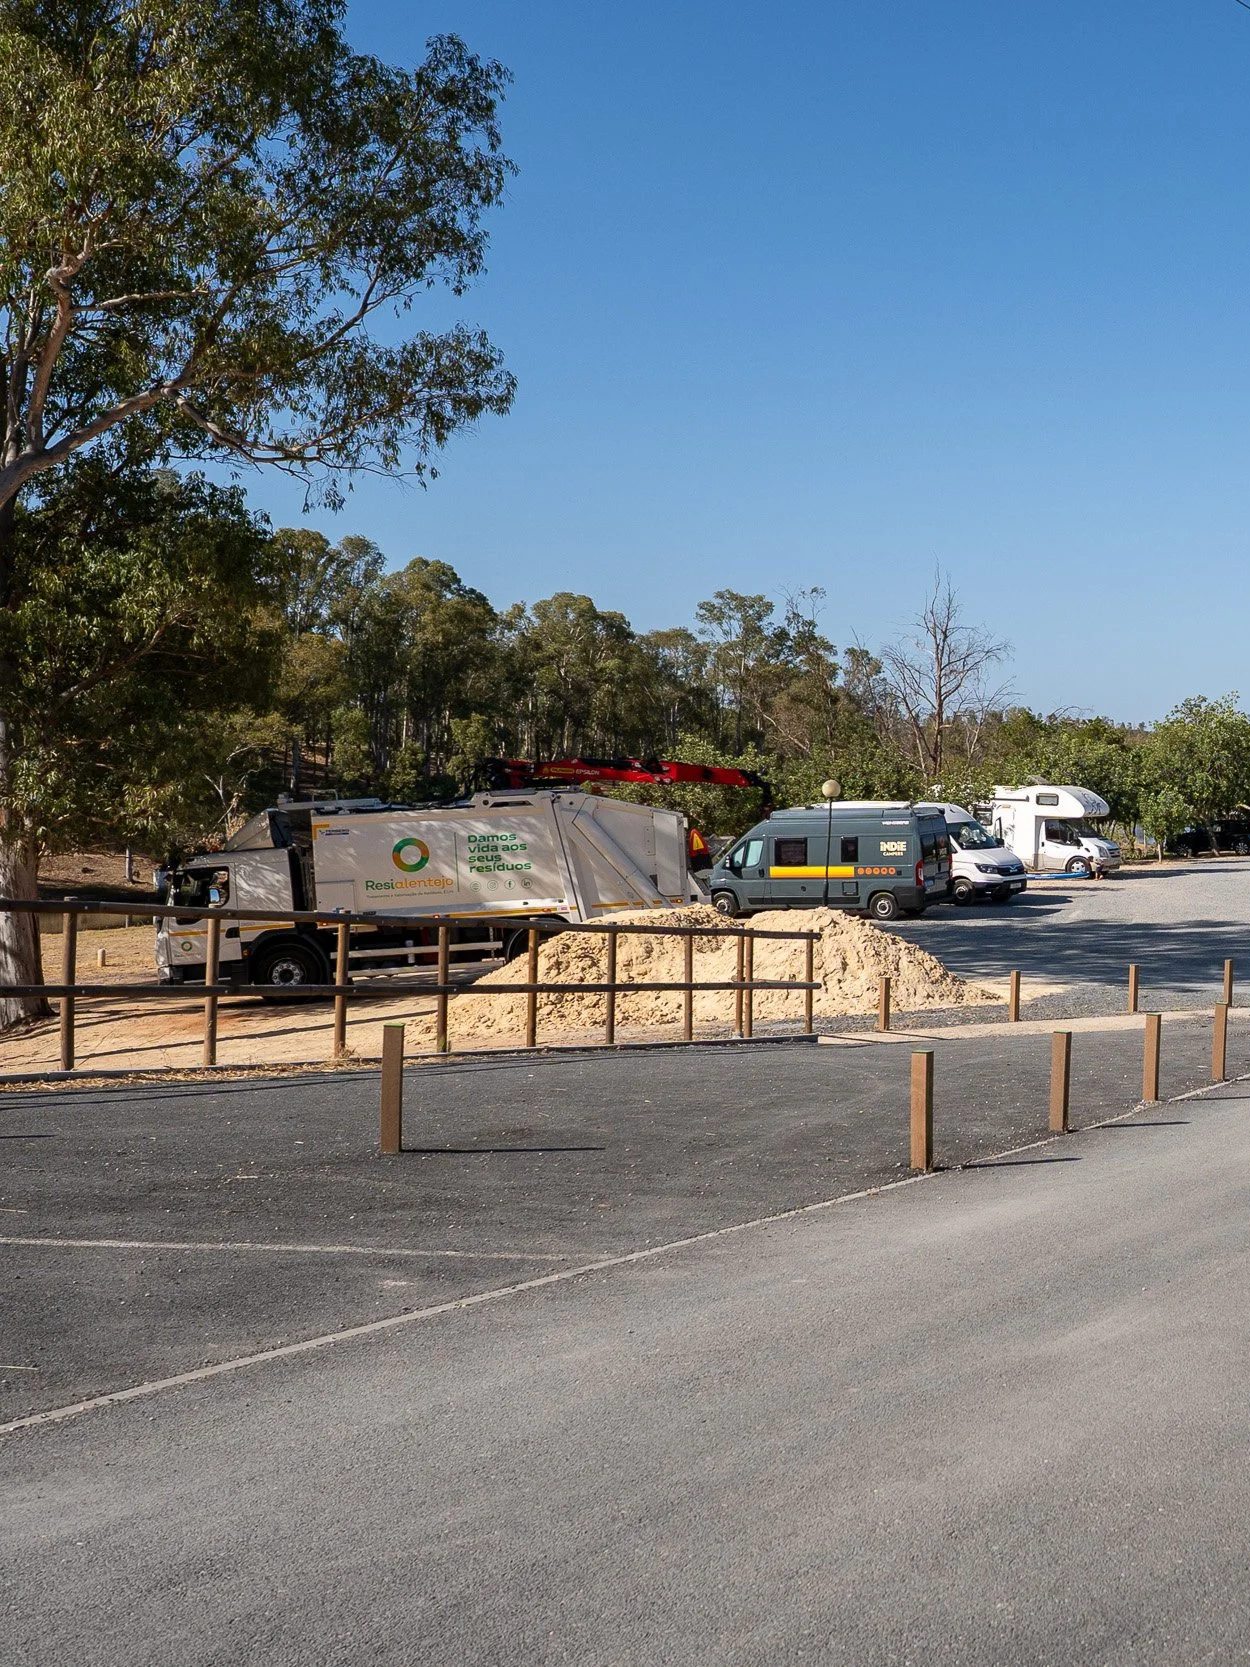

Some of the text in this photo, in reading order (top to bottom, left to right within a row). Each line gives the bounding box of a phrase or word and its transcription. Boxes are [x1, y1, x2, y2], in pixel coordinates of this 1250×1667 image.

[468, 834, 517, 843] Damos
[468, 843, 528, 854] vida aos
[468, 854, 502, 863] seus
[470, 862, 532, 873] resíduos
[364, 876, 454, 890] Resialentejo
